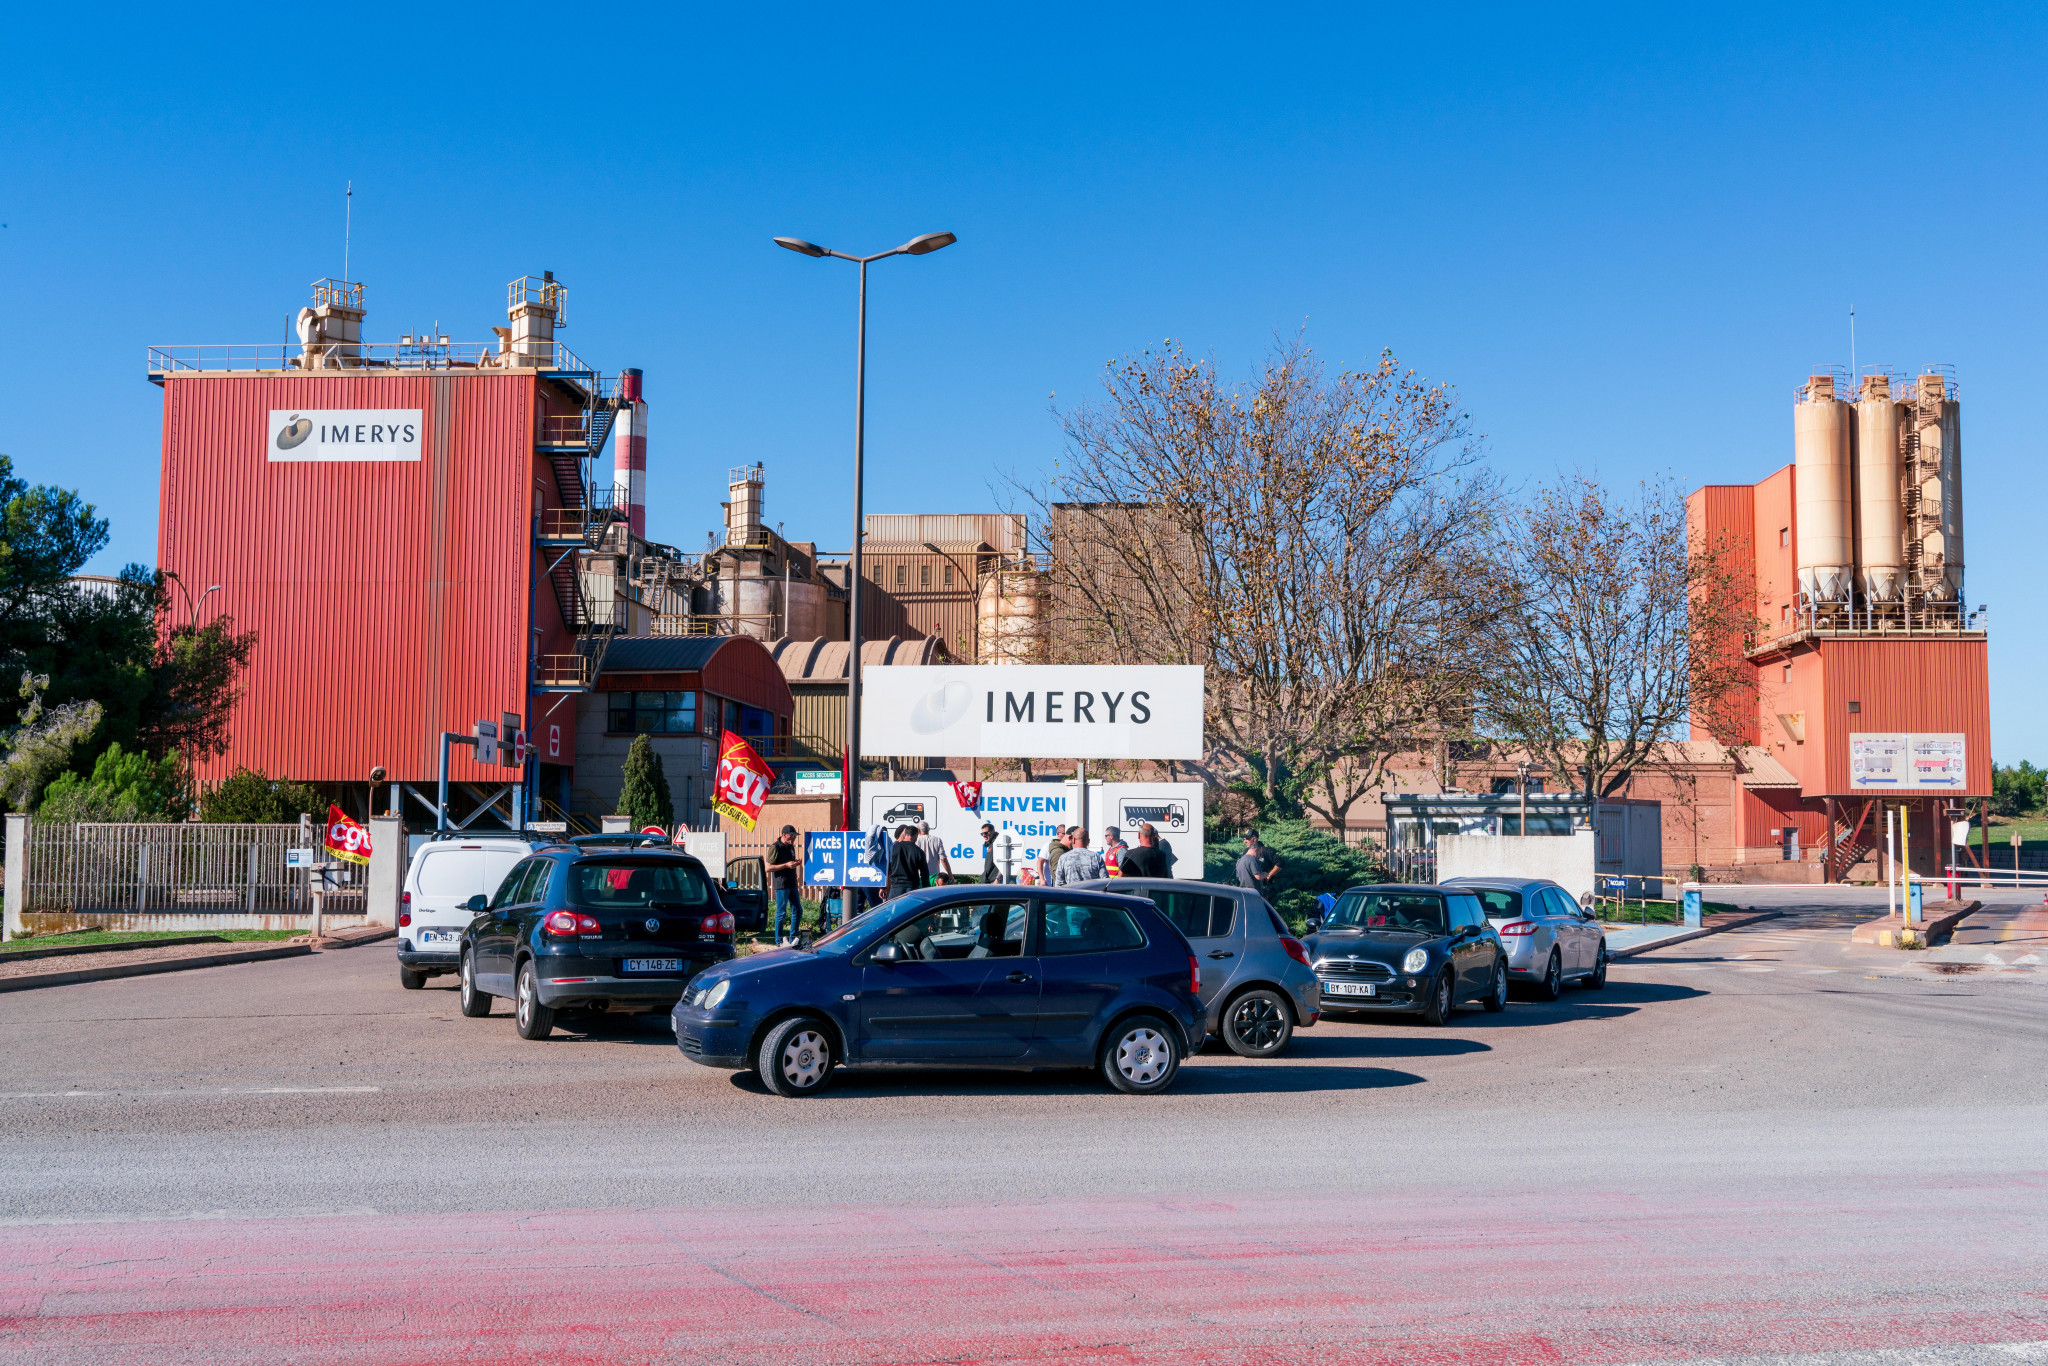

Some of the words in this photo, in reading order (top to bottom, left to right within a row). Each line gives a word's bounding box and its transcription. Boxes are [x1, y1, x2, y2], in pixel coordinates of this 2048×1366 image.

[321, 424, 415, 443] IMERYS
[986, 691, 1152, 724] IMERYS
[718, 759, 771, 807] cgt
[965, 796, 1066, 812] IENVEN
[728, 807, 742, 821] SUR
[1003, 820, 1057, 837] l'usin
[331, 824, 371, 851] cgt
[815, 835, 842, 849] ACCÈS
[849, 838, 866, 850] ACC
[822, 852, 834, 864] VL
[857, 852, 869, 864] PL
[950, 843, 974, 859] de
[629, 960, 677, 970] CY-148-ZE
[1329, 983, 1370, 995] BY-107-KA
